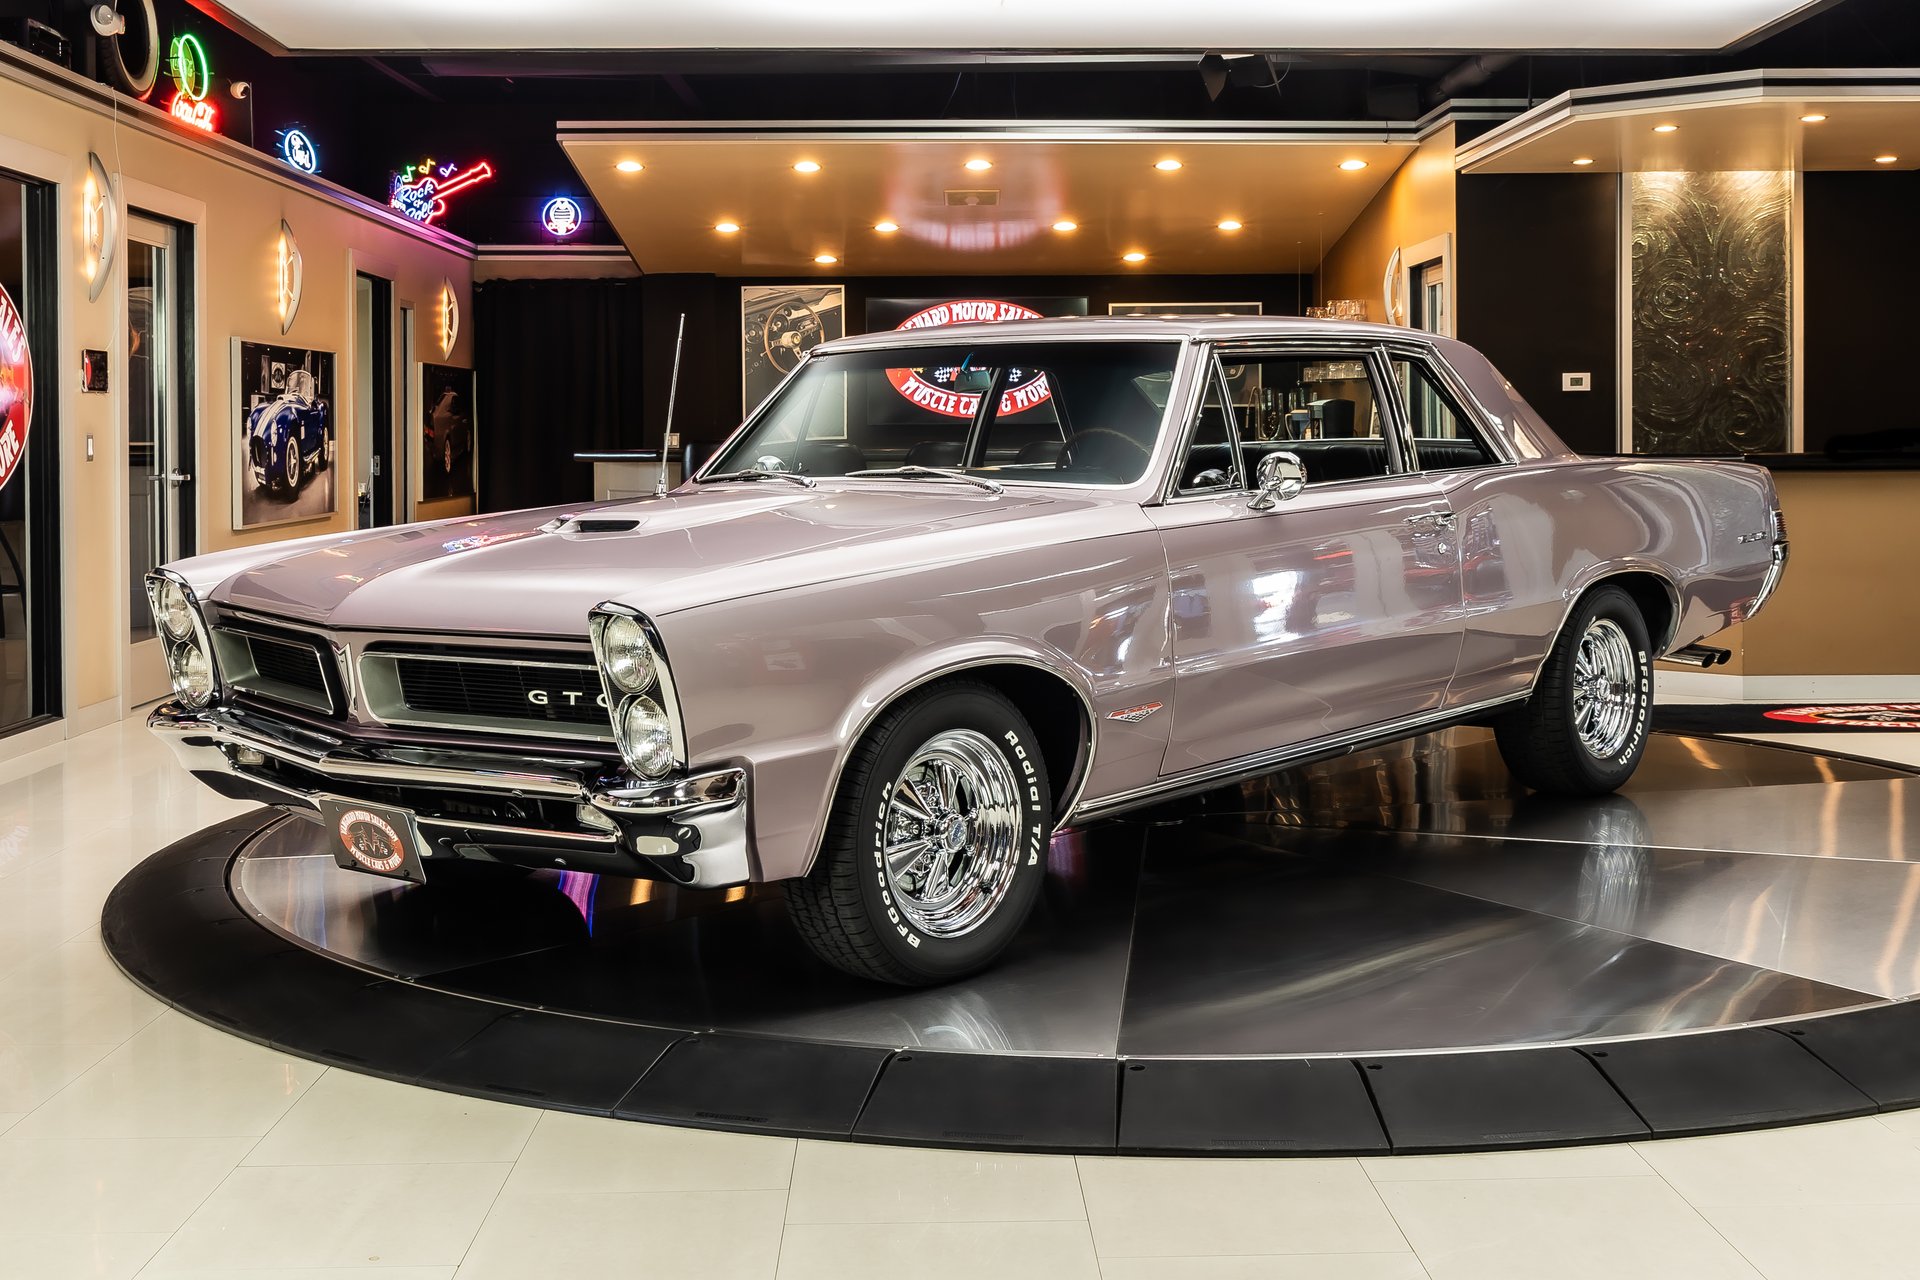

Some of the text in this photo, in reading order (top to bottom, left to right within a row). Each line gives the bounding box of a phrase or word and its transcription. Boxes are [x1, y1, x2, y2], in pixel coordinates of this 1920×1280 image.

[401, 180, 434, 203] Rock
[0, 296, 26, 363] ALES
[950, 302, 997, 321] MOTOR
[997, 303, 1040, 321] SALE
[900, 376, 1049, 415] MUSCLE CA & MOR
[0, 419, 19, 478] ORE
[1618, 650, 1649, 765] BFGoodrich
[1004, 730, 1042, 866] Radial T/A
[873, 781, 921, 949] BFGoodrich
